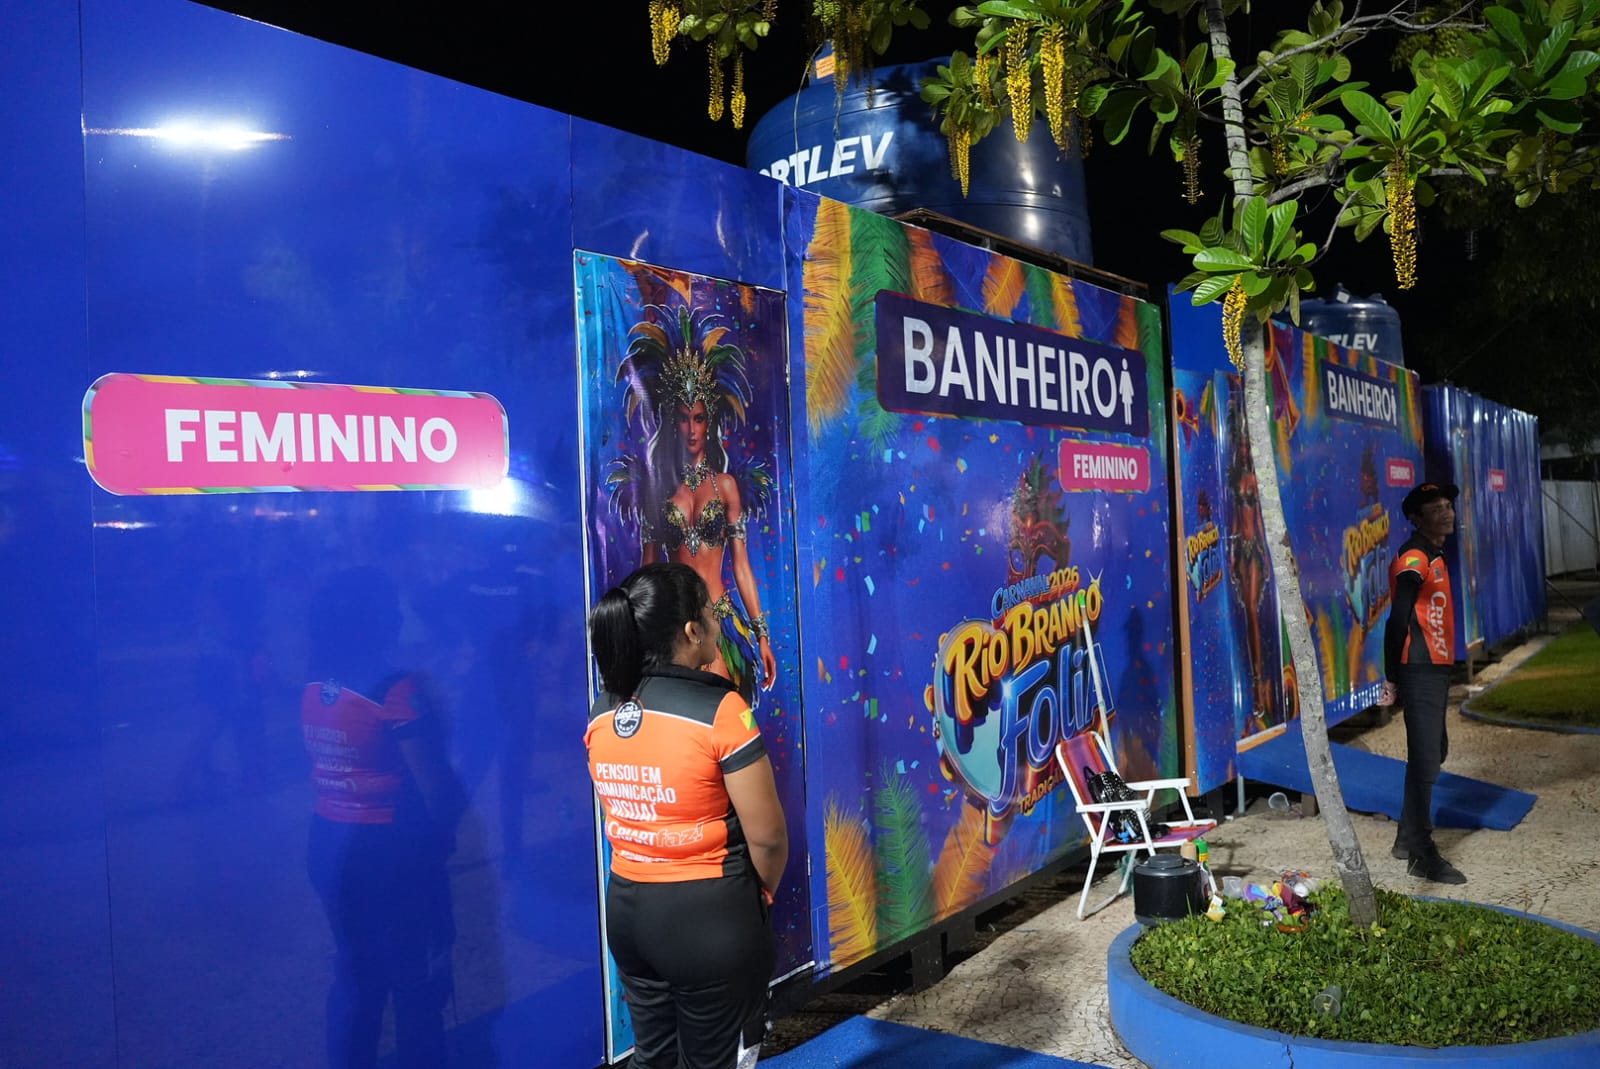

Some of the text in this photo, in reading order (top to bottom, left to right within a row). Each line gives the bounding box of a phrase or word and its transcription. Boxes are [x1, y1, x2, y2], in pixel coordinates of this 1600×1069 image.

[903, 316, 1118, 418] BANHEIRO
[1327, 370, 1391, 422] BANHEIRO
[164, 408, 457, 463] FEMININO
[1073, 454, 1138, 480] FEMININO
[991, 565, 1080, 619] CARNAVAL 2026
[1005, 583, 1101, 676] BRANCO
[594, 780, 676, 804] COMUNICAÇÃO
[595, 763, 661, 784] PENSOU EM
[655, 821, 705, 848] faz!
